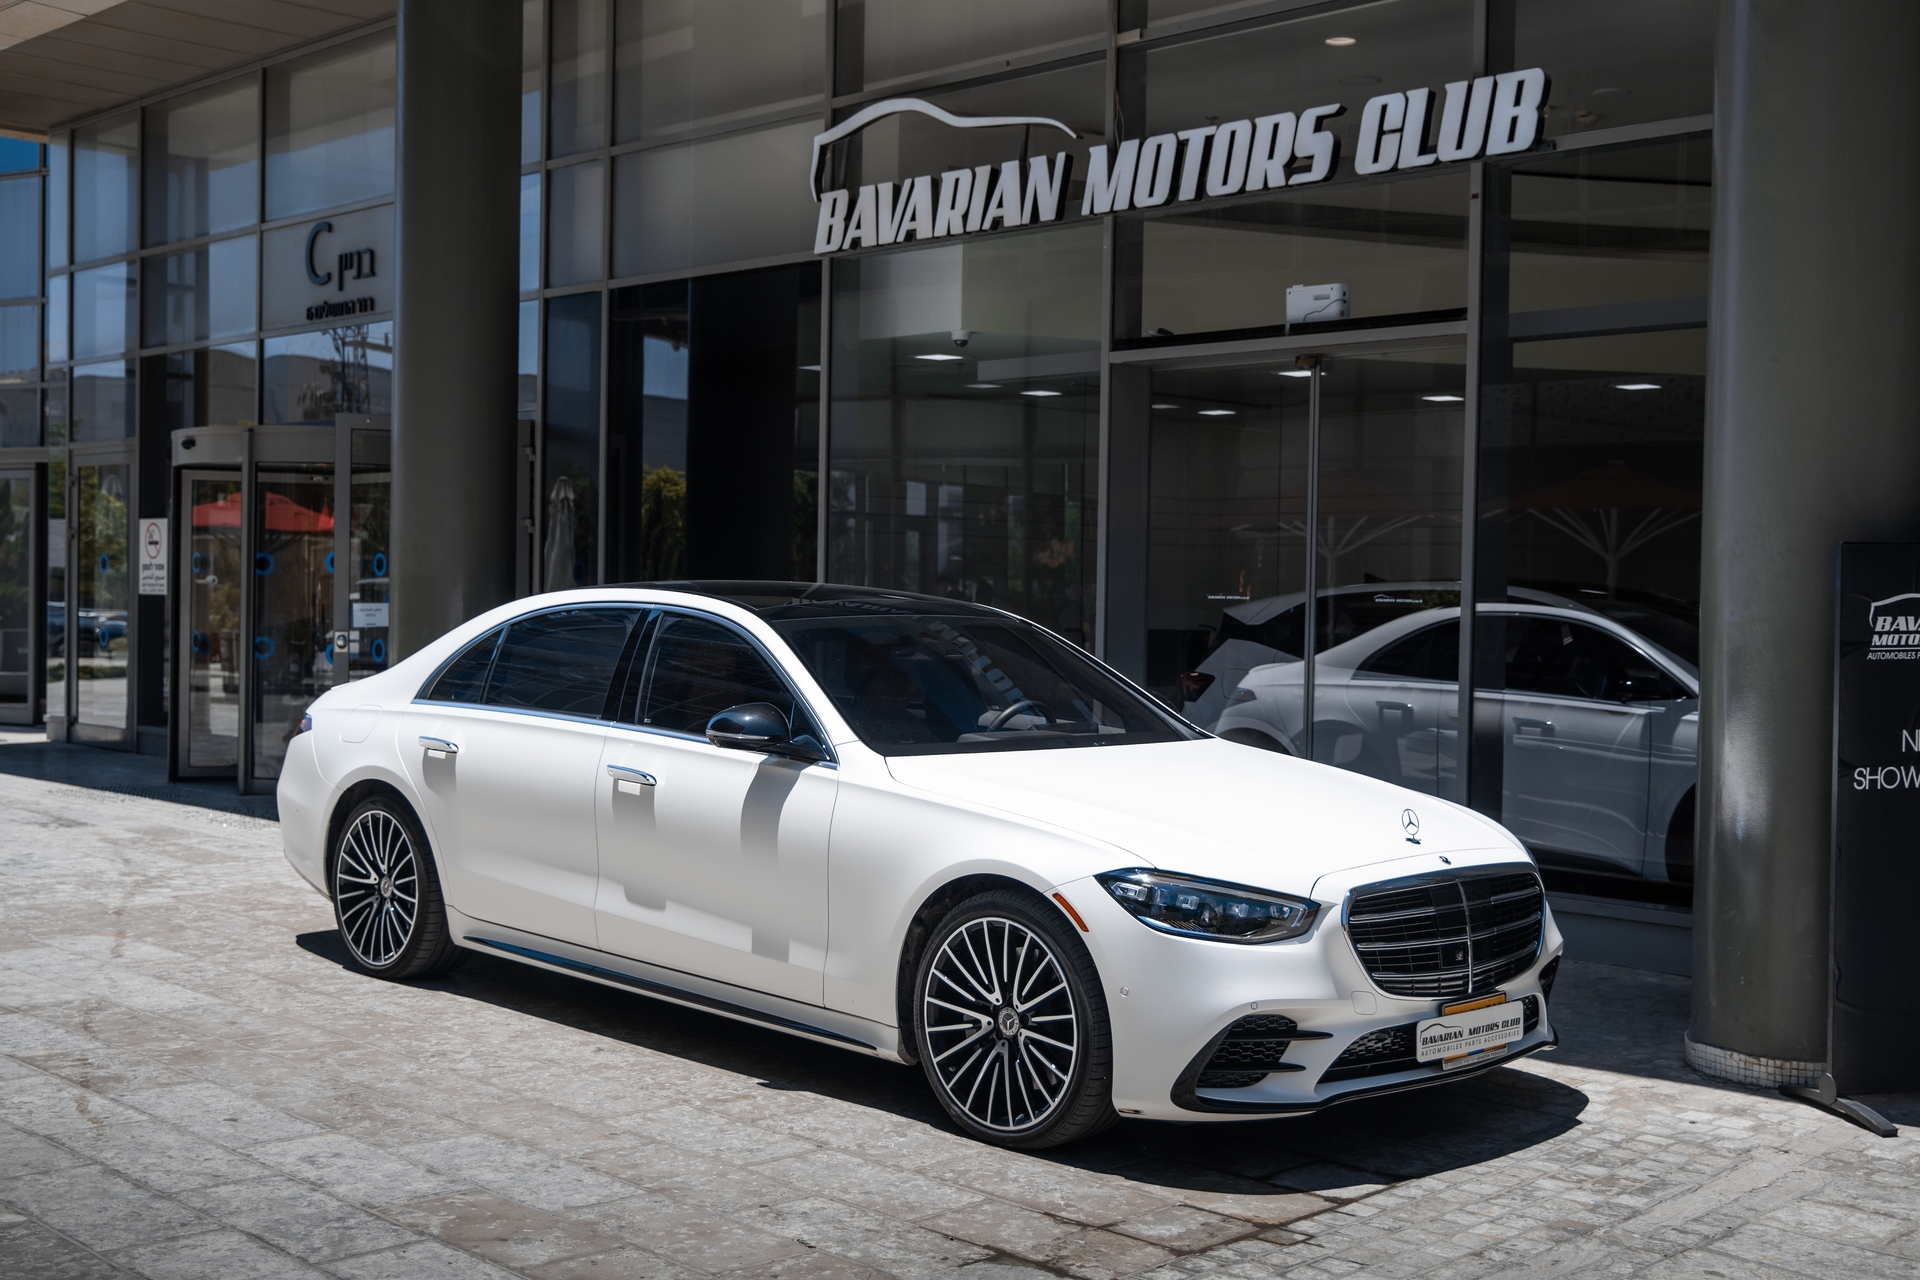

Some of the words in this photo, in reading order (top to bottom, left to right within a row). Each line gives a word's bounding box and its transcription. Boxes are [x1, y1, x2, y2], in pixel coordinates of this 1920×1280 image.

[814, 152, 1072, 255] BAVARIAN
[1081, 104, 1347, 217] MOTORS
[1354, 67, 1552, 175] CLUB
[306, 221, 332, 285] C
[1874, 616, 1920, 631] BAV
[1872, 634, 1920, 645] MOTO
[1867, 651, 1916, 660] AUTOMOBILES
[1902, 729, 1920, 752] N
[1422, 1030, 1464, 1046] BAVARIAN
[1468, 1021, 1499, 1036] MOTORS
[1501, 1017, 1521, 1029] CLUB
[1421, 1043, 1462, 1057] AUTOMOBILES
[1465, 1039, 1482, 1047] PARTS
[1484, 1031, 1520, 1043] ACCESSORIES
